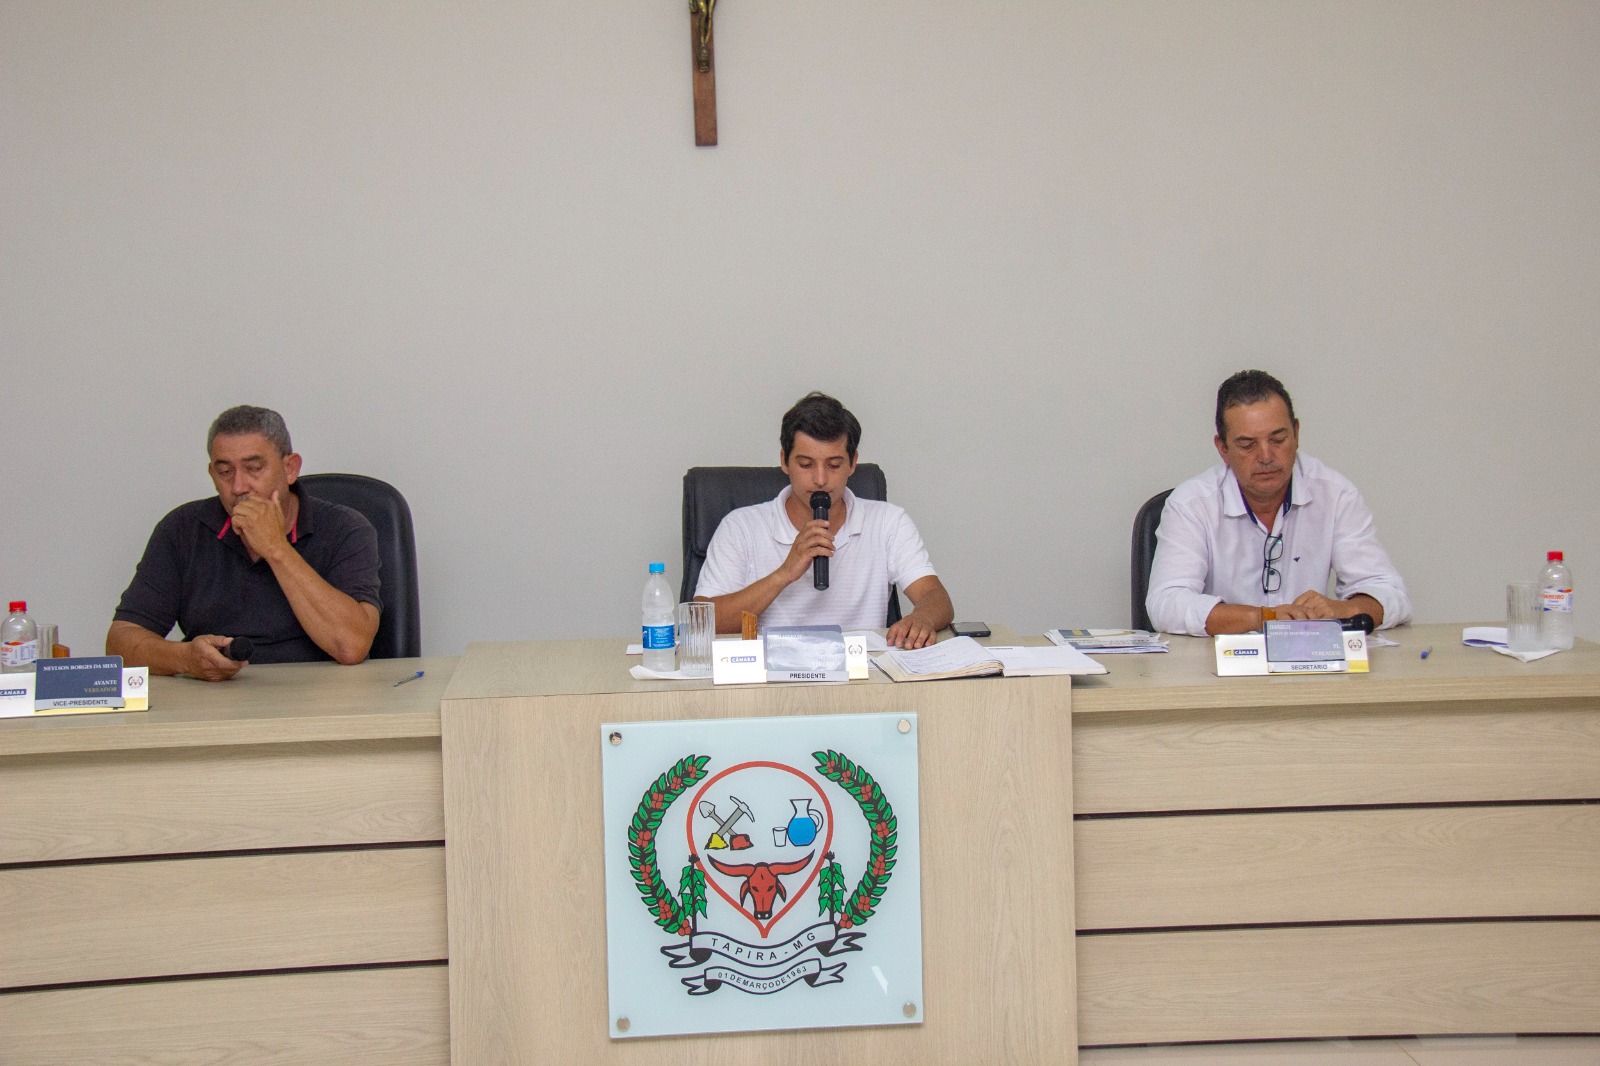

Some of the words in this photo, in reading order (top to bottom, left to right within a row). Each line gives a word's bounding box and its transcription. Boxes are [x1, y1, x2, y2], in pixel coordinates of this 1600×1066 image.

[53, 699, 108, 707] VICE-PRESIDENTE
[711, 938, 777, 961] TAPIRA
[792, 932, 816, 951] MG
